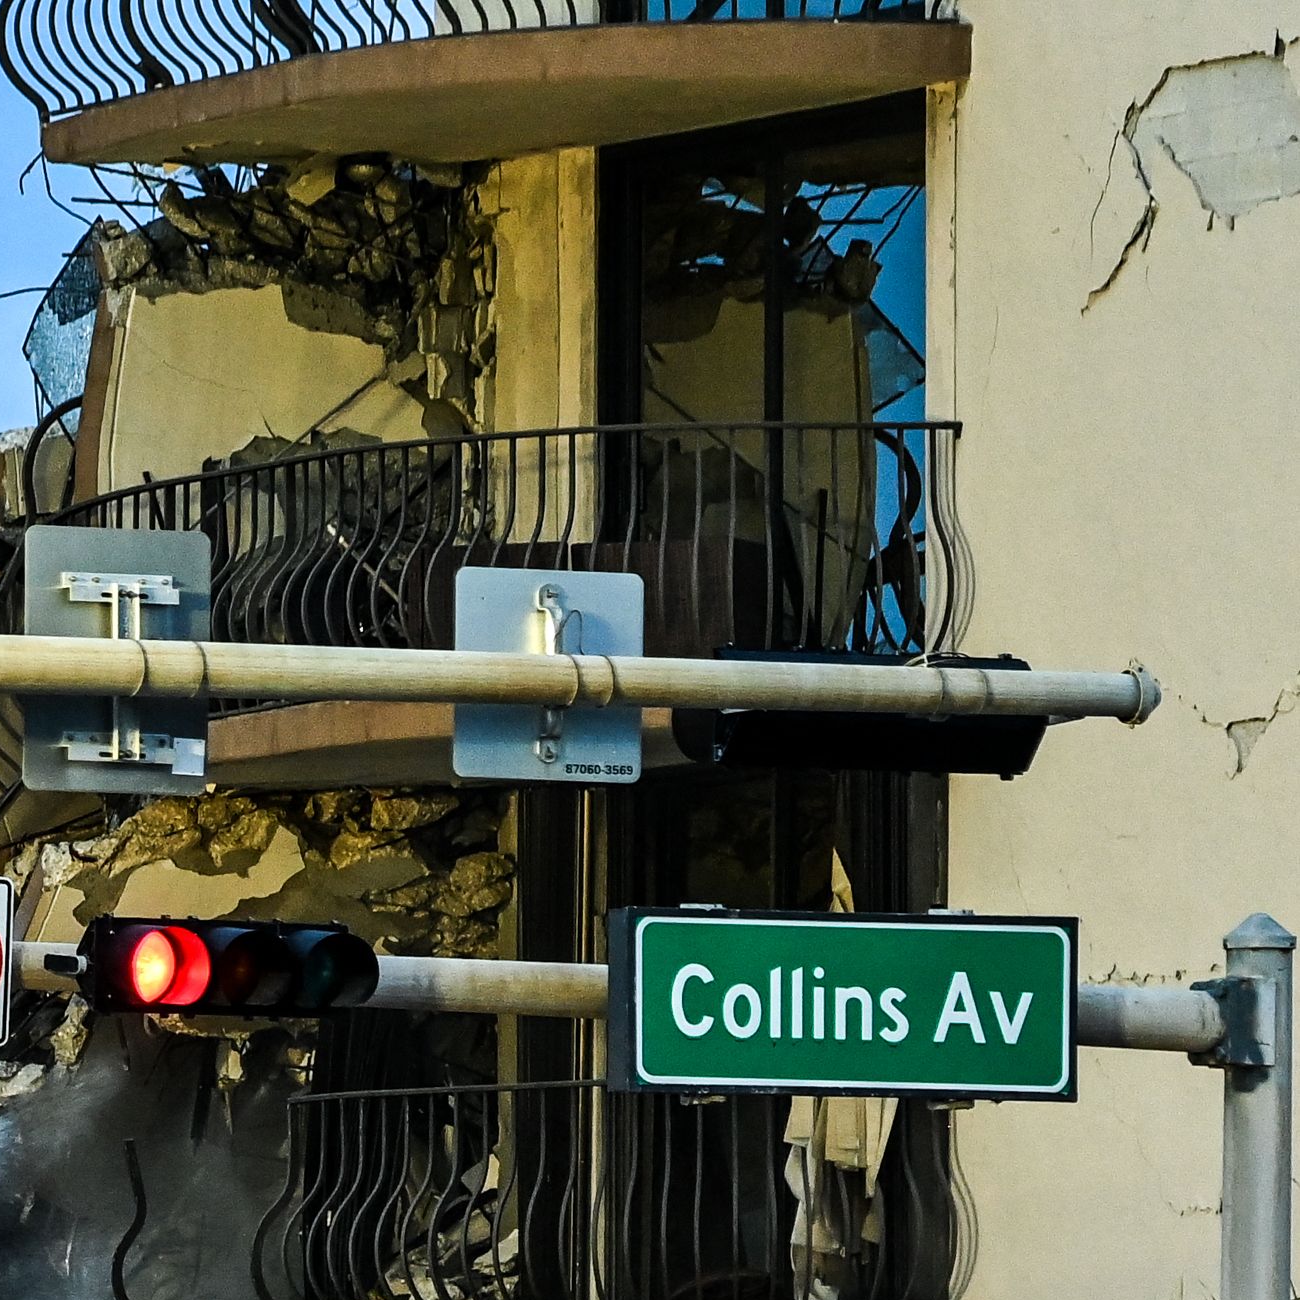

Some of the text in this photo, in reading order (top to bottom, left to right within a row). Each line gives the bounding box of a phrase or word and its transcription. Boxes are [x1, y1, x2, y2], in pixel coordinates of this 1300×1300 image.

[565, 763, 634, 776] 87060-3569
[670, 962, 1034, 1045] Collins Av
